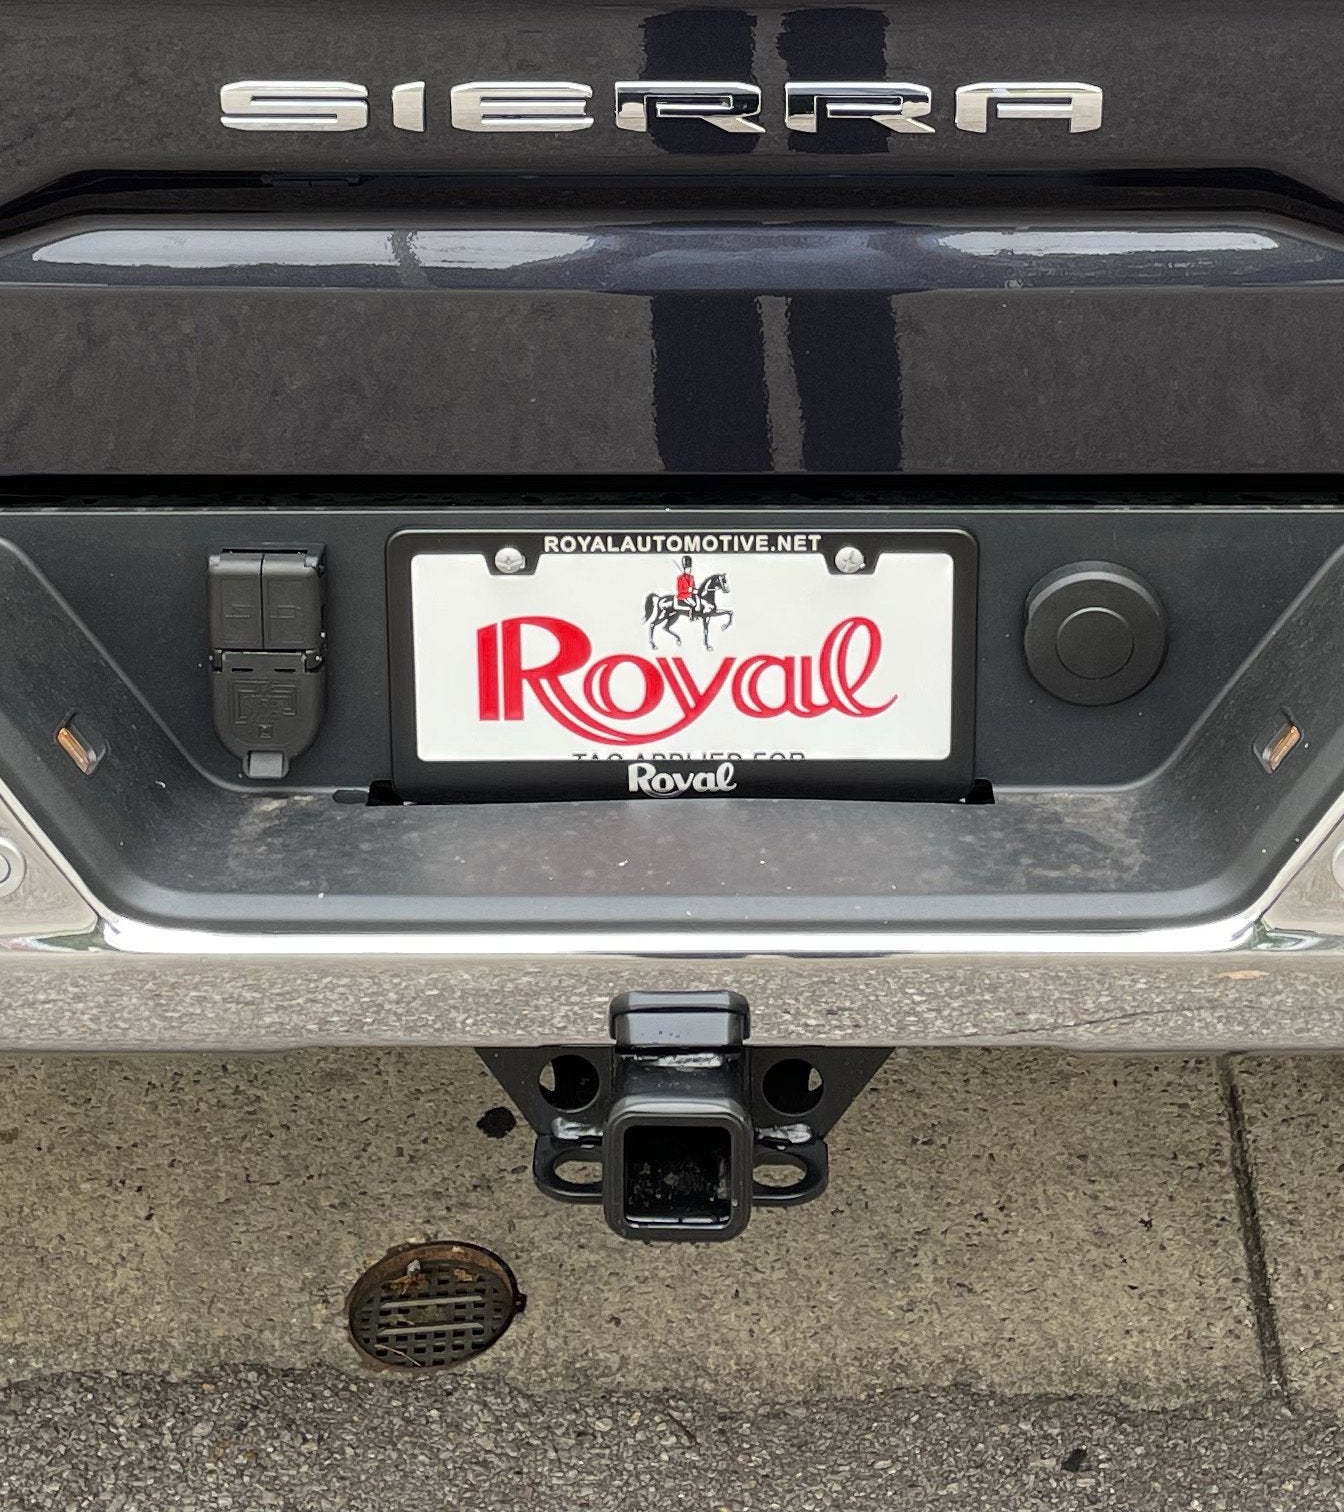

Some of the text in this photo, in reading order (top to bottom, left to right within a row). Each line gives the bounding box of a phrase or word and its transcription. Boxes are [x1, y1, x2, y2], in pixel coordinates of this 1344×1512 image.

[219, 80, 1105, 134] SIERRA
[543, 534, 822, 552] ROYALAUTOMOTIVE.NET
[476, 615, 898, 746] Royal
[627, 761, 738, 799] Royal
